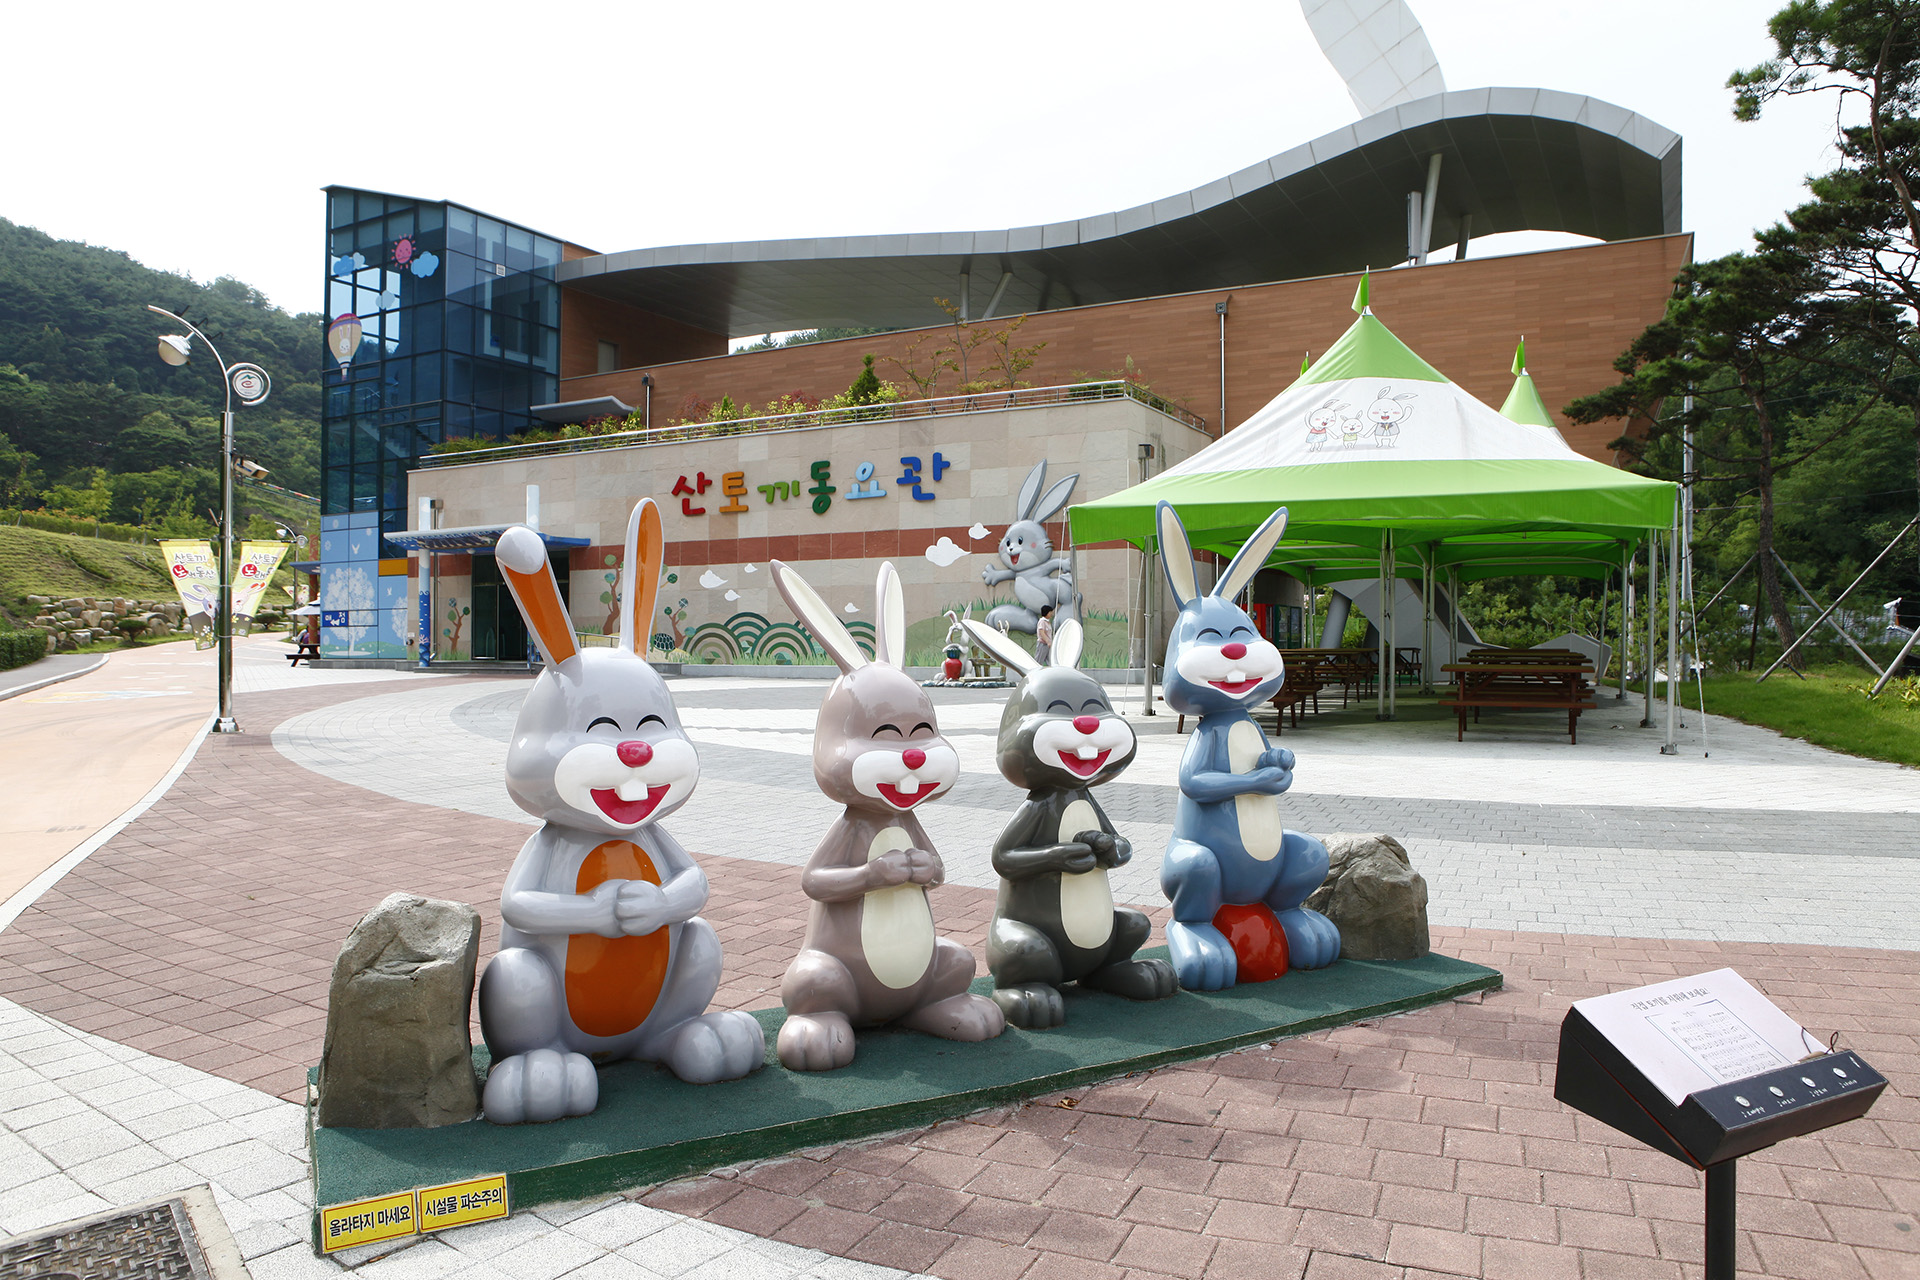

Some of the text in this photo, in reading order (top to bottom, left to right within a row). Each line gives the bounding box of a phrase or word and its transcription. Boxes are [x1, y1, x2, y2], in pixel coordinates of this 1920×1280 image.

[671, 452, 950, 516] 산토끼동요관
[174, 553, 207, 564] 산토끼
[425, 1187, 503, 1217] 시설물 파손주의
[329, 1205, 411, 1237] 올라타지 마세요
